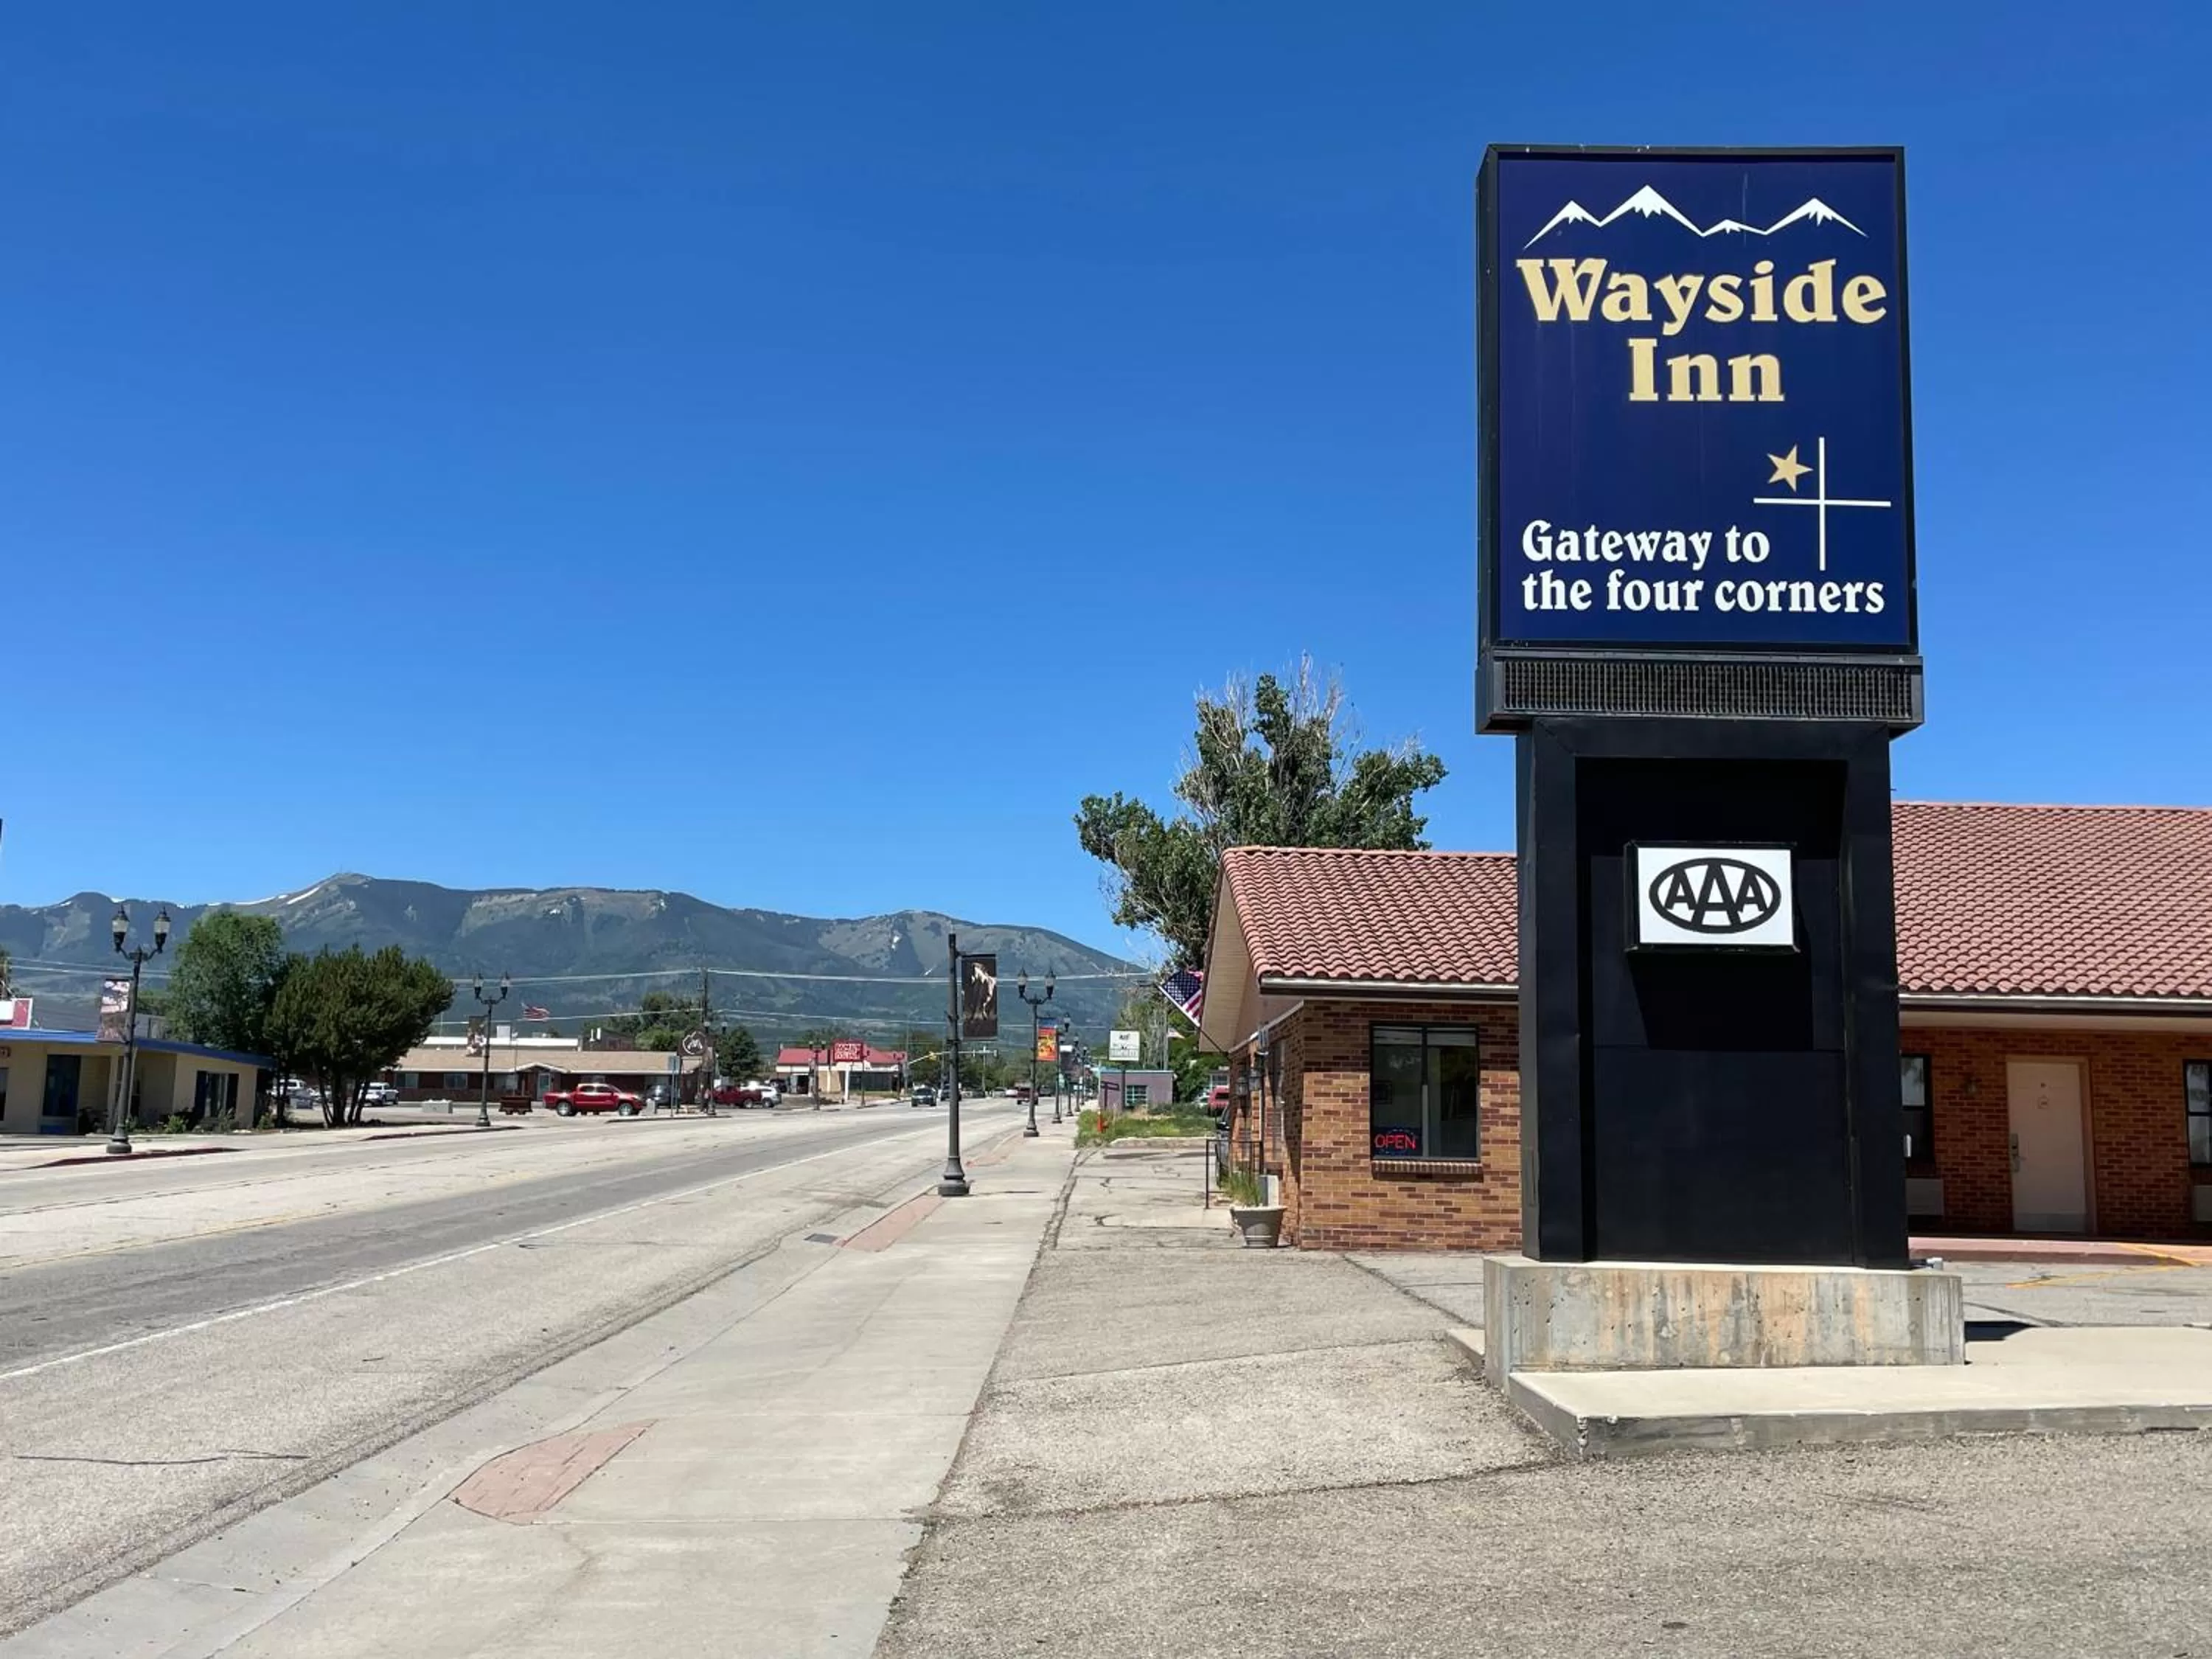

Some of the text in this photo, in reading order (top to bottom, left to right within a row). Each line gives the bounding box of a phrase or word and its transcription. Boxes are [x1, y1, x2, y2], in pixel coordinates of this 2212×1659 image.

[1517, 258, 1887, 335] Wayside
[1628, 338, 1784, 402] Inn
[1523, 520, 1770, 571] Gateway to
[1523, 569, 1885, 613] the four corners
[1663, 861, 1769, 929] AAA
[1374, 1133, 1416, 1150] OPEN
